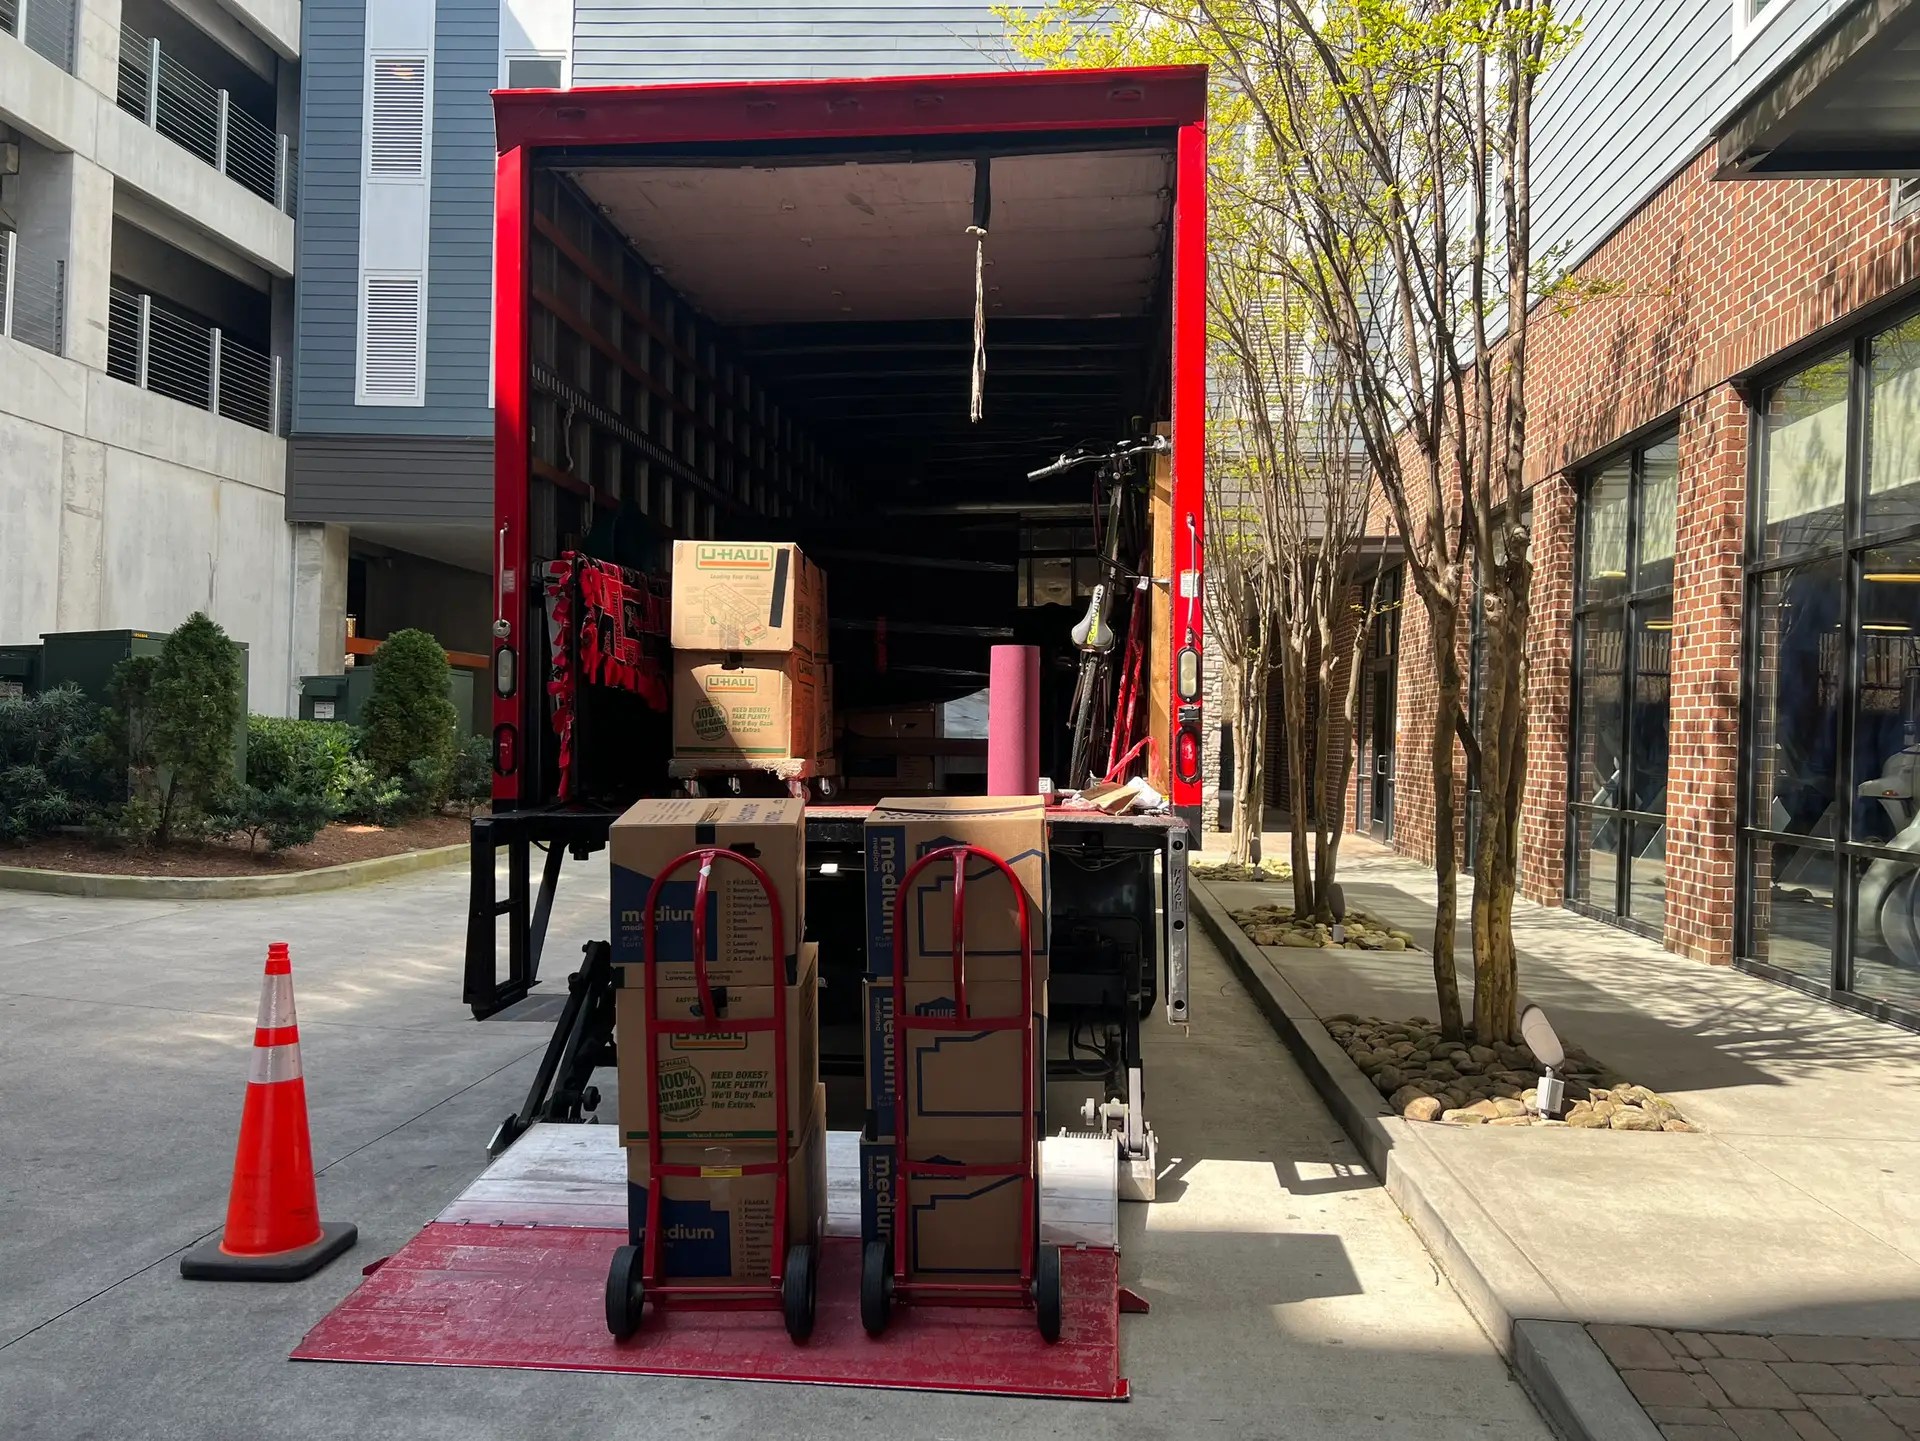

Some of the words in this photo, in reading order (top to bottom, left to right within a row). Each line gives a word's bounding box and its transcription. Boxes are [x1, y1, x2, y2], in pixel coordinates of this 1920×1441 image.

[701, 548, 768, 561] U-HAUL
[1088, 588, 1102, 641] SCHWINN
[709, 678, 754, 687] U-HAUL
[697, 705, 723, 720] 100%
[880, 837, 899, 935] medium
[620, 905, 695, 922] mdium
[660, 1069, 696, 1091] 100%
[710, 1071, 733, 1080] NEED
[735, 1071, 769, 1080] BOXES?
[711, 1081, 732, 1089] TAKE
[734, 1081, 768, 1089] PLENTY!
[711, 1091, 732, 1099] We'll
[734, 1091, 750, 1101] Buy
[752, 1090, 774, 1099] Back
[727, 1101, 756, 1109] Extras.
[876, 1155, 898, 1236] mediu
[638, 1223, 715, 1240] dium
